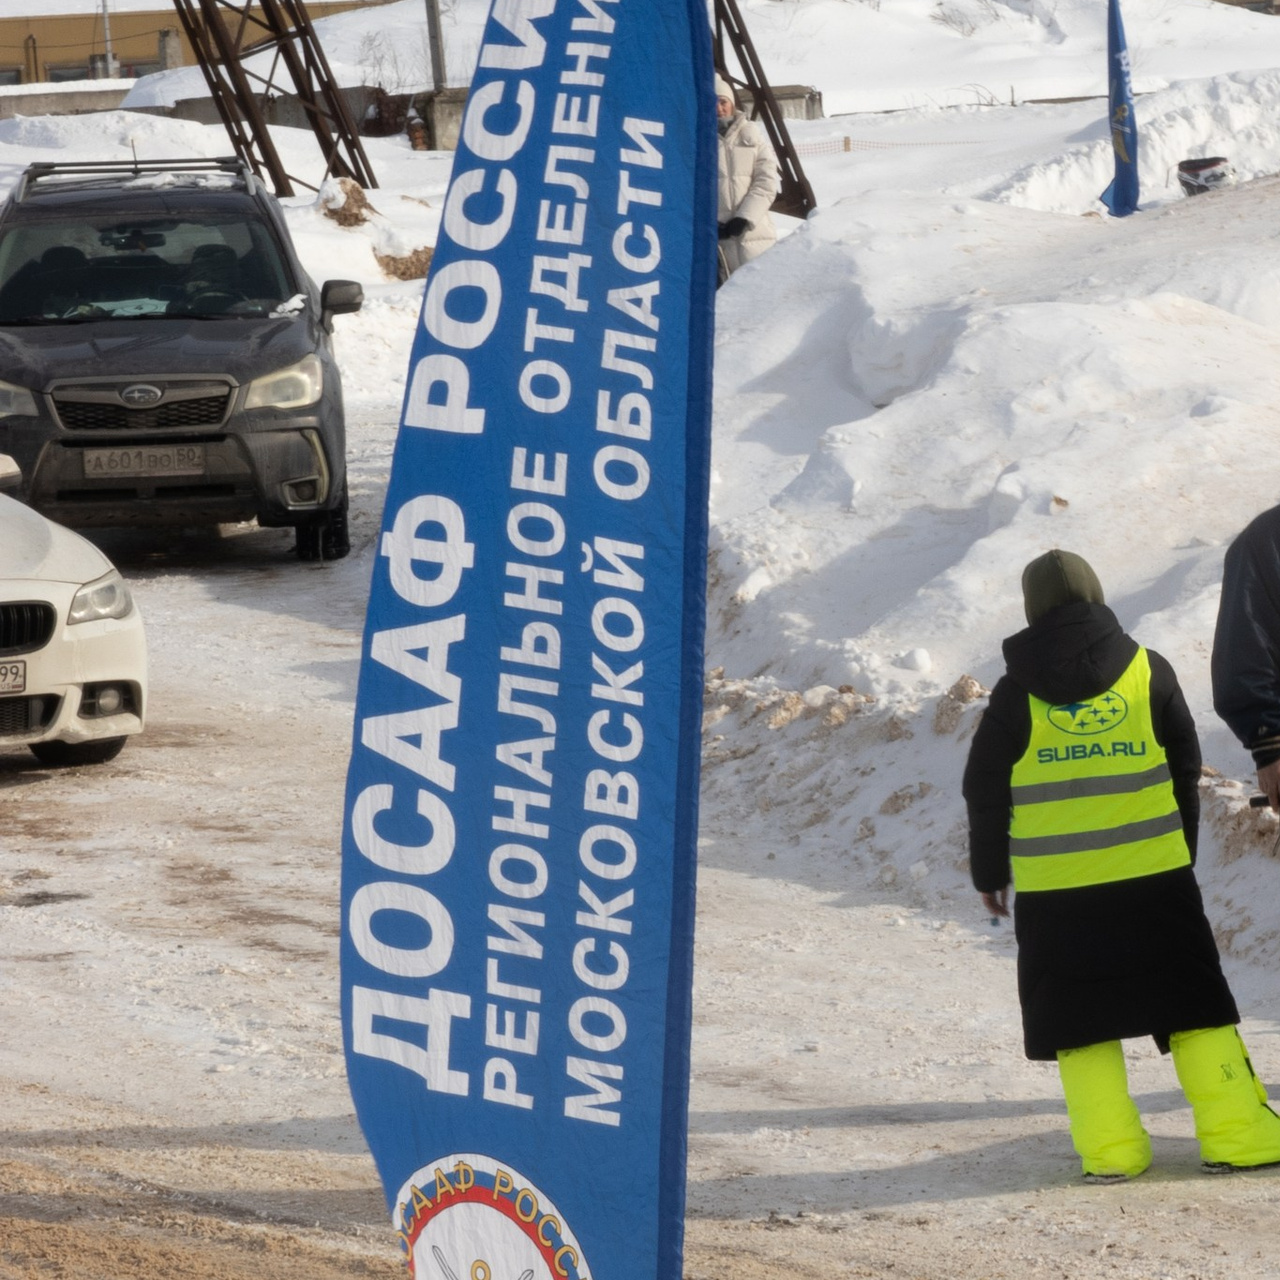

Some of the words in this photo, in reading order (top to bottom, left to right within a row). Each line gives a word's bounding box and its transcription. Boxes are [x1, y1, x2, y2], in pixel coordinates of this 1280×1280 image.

[593, 117, 665, 502] ОБЛАСТИ
[348, 493, 476, 1097] ДОСААФ
[482, 445, 569, 1111] РЕГИОНАЛЬНОЕ
[563, 540, 646, 1128] МОСКОВСКОЙ
[1037, 741, 1146, 764] SUBA.RU
